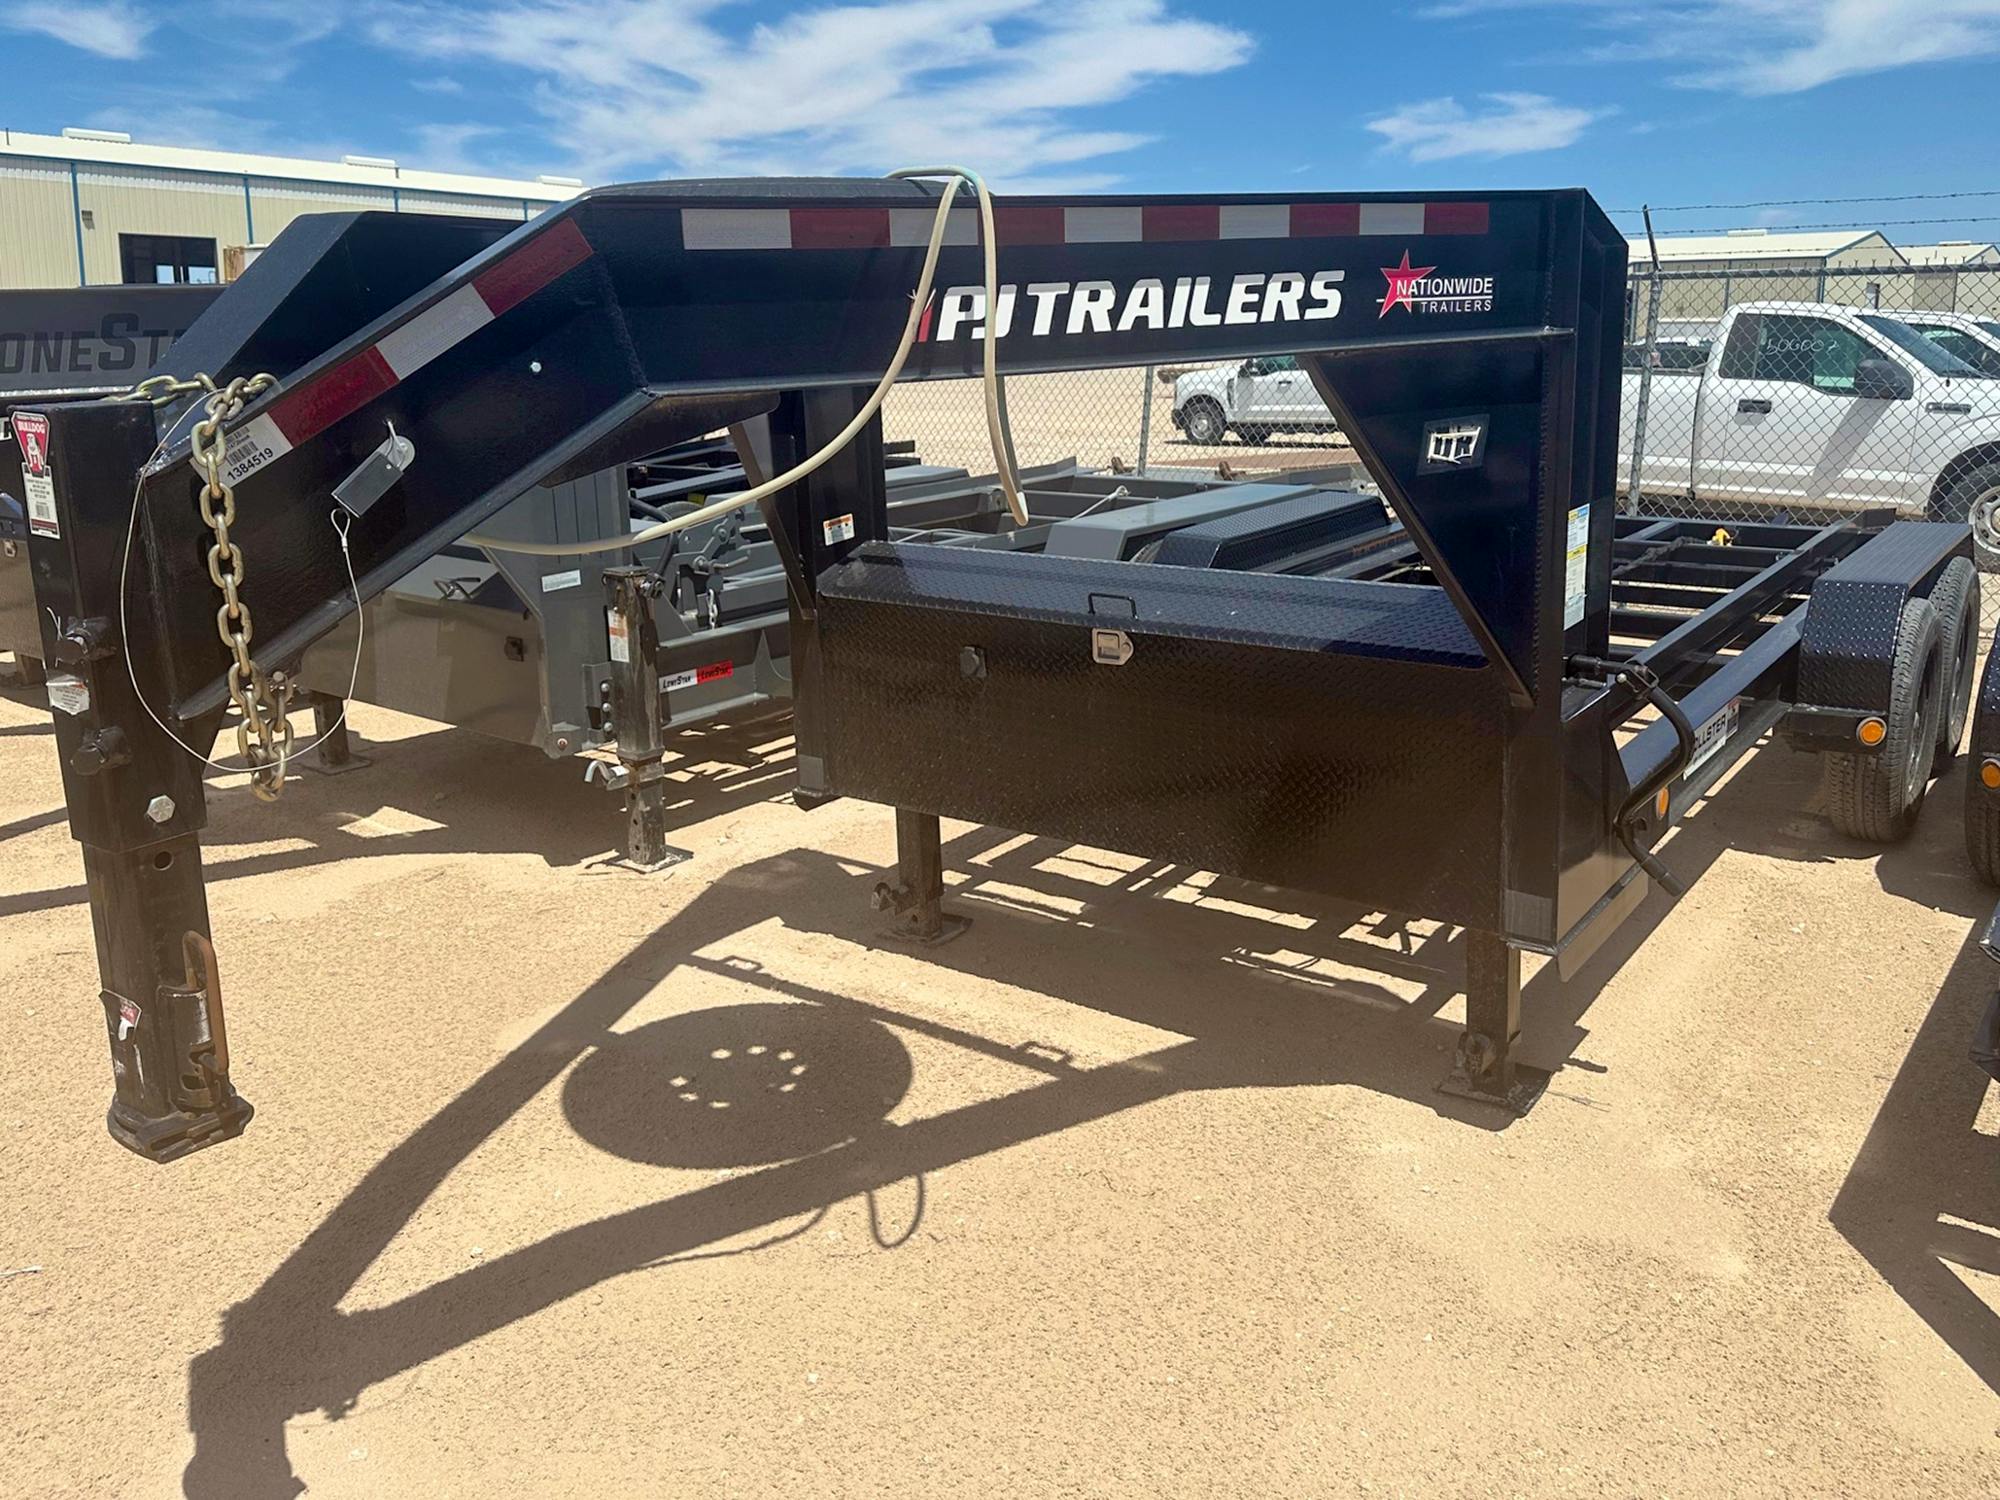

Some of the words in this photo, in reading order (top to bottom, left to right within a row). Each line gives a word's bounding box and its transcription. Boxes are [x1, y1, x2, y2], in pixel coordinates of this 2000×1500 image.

[1395, 277, 1494, 296] NATIONWIDE
[936, 283, 1018, 342] PJ
[1026, 269, 1346, 338] TRAILERS
[1420, 299, 1492, 313] TRAILERS
[17, 420, 46, 435] BULLDOG
[227, 447, 274, 481] 1384519
